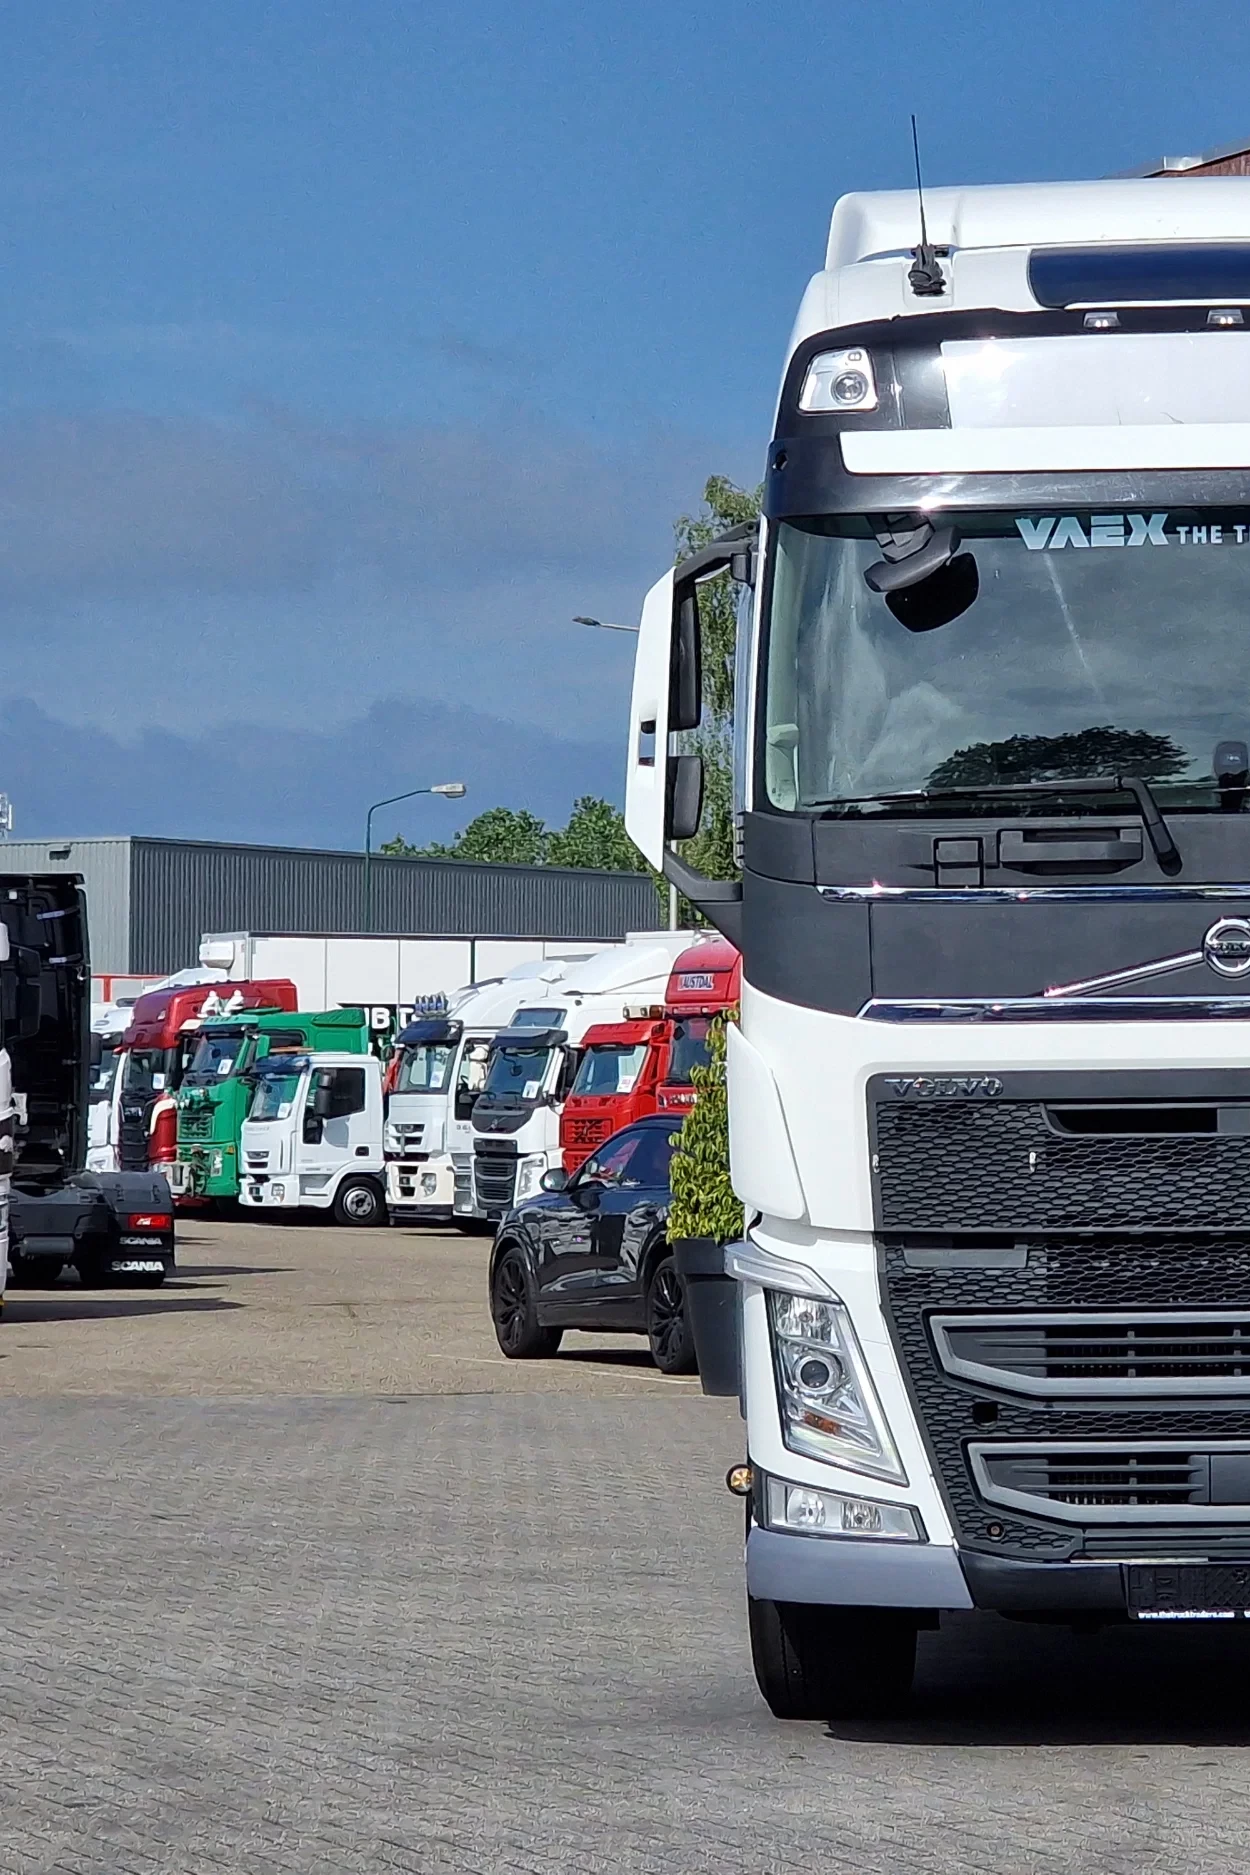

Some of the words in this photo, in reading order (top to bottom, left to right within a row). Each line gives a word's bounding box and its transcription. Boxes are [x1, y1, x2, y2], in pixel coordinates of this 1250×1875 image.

[1015, 513, 1169, 550] VAEX
[1176, 525, 1223, 545] THE
[884, 1077, 1003, 1096] VOLVO
[119, 1236, 163, 1246] SCANIA
[111, 1260, 165, 1271] SCANIA
